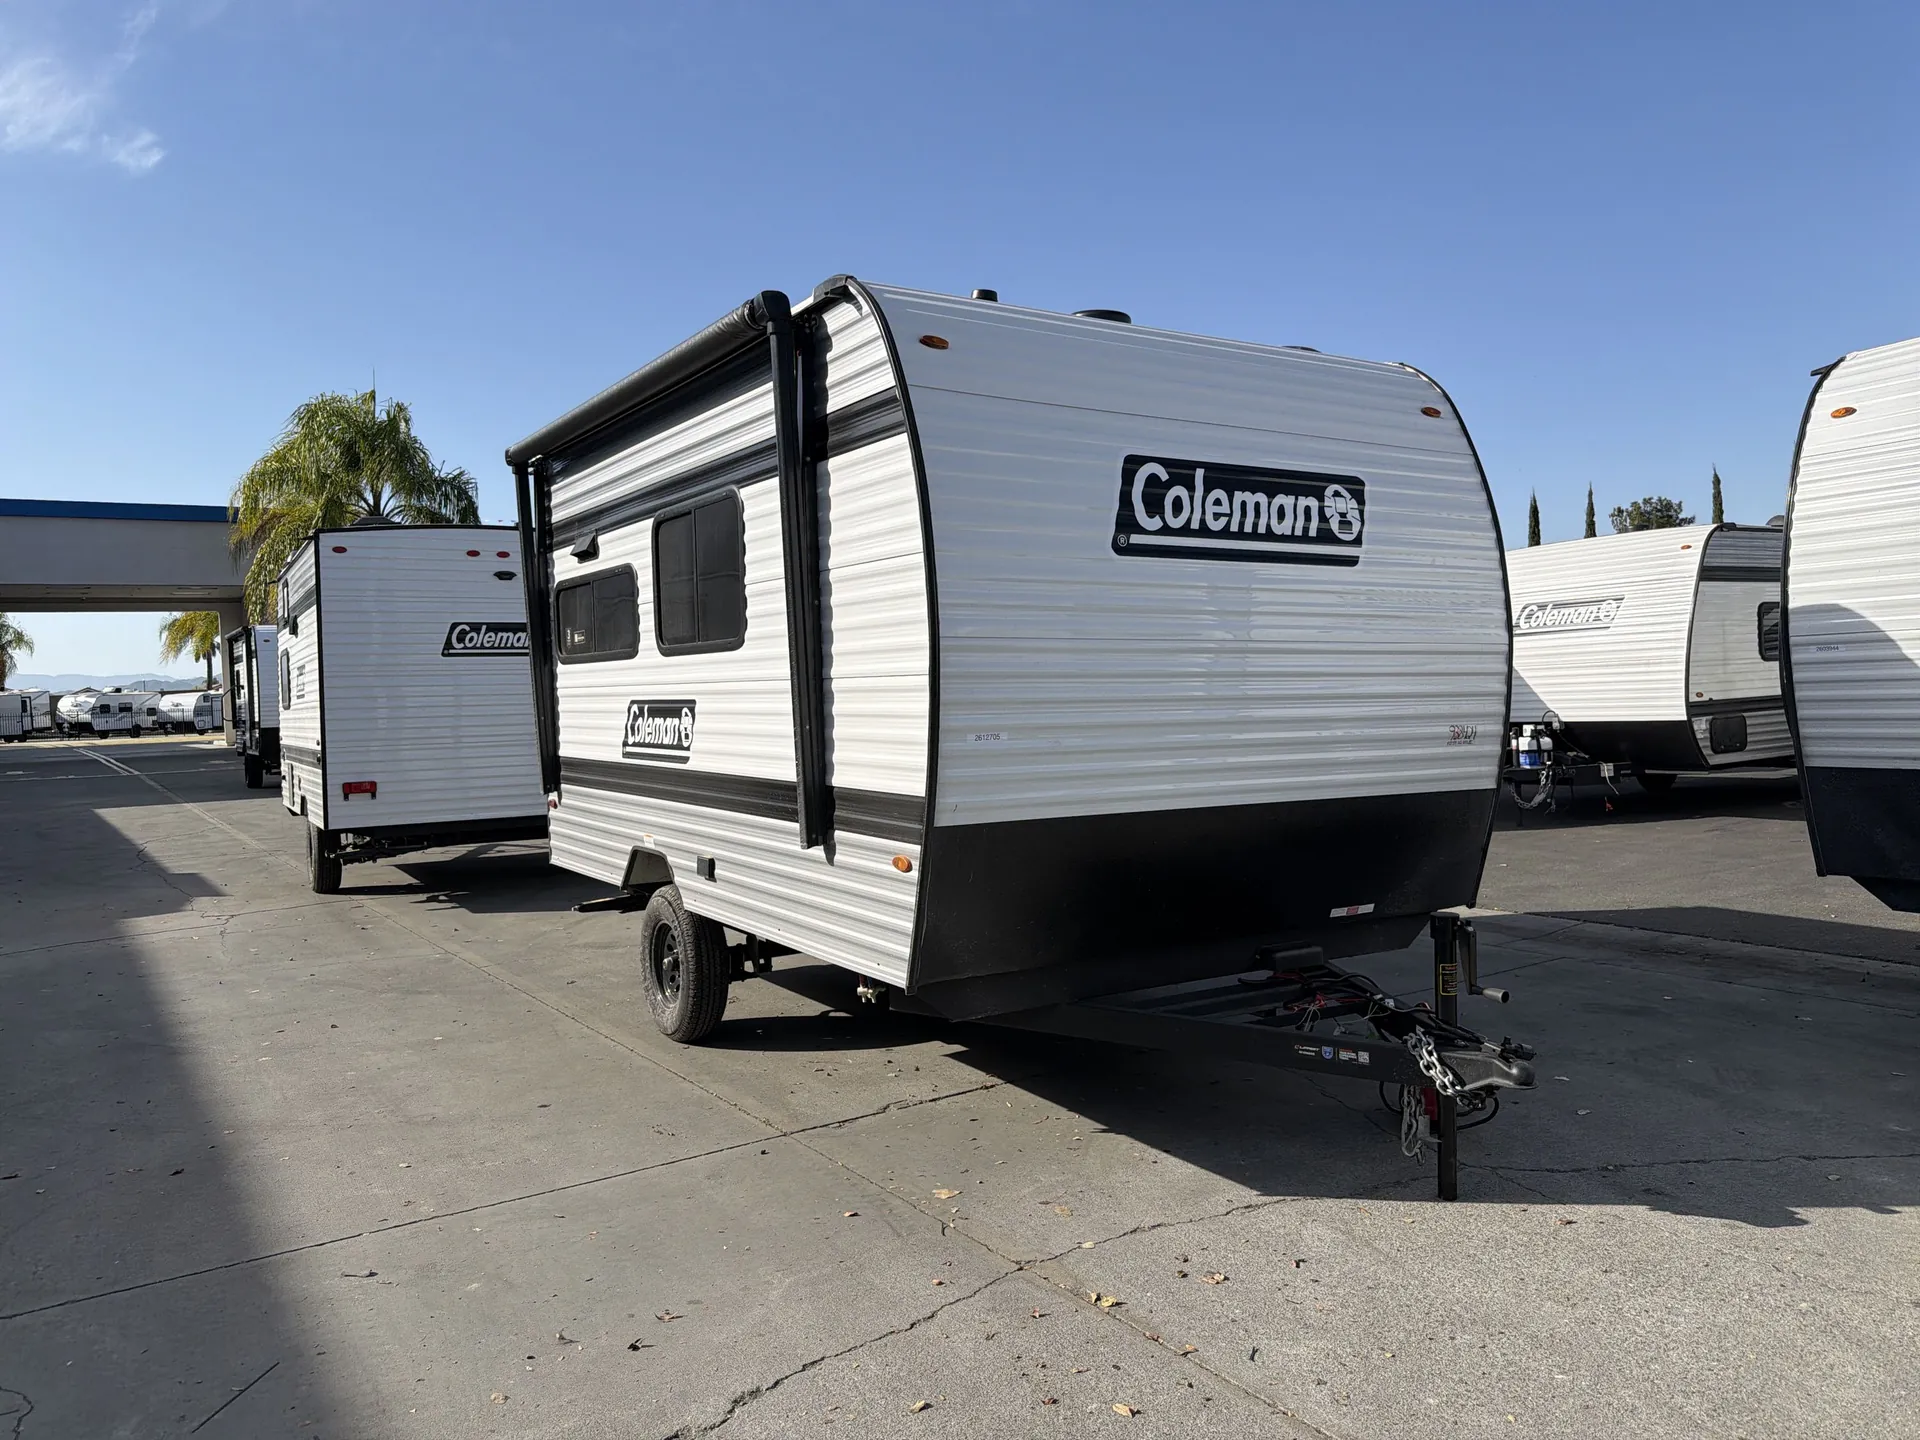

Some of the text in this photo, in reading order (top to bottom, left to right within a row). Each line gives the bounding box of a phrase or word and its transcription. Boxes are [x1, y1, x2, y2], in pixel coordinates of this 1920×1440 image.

[1131, 462, 1319, 537] Coleman
[1519, 604, 1597, 629] Coleman
[627, 703, 680, 745] Coleman
[974, 733, 1001, 742] 2612705
